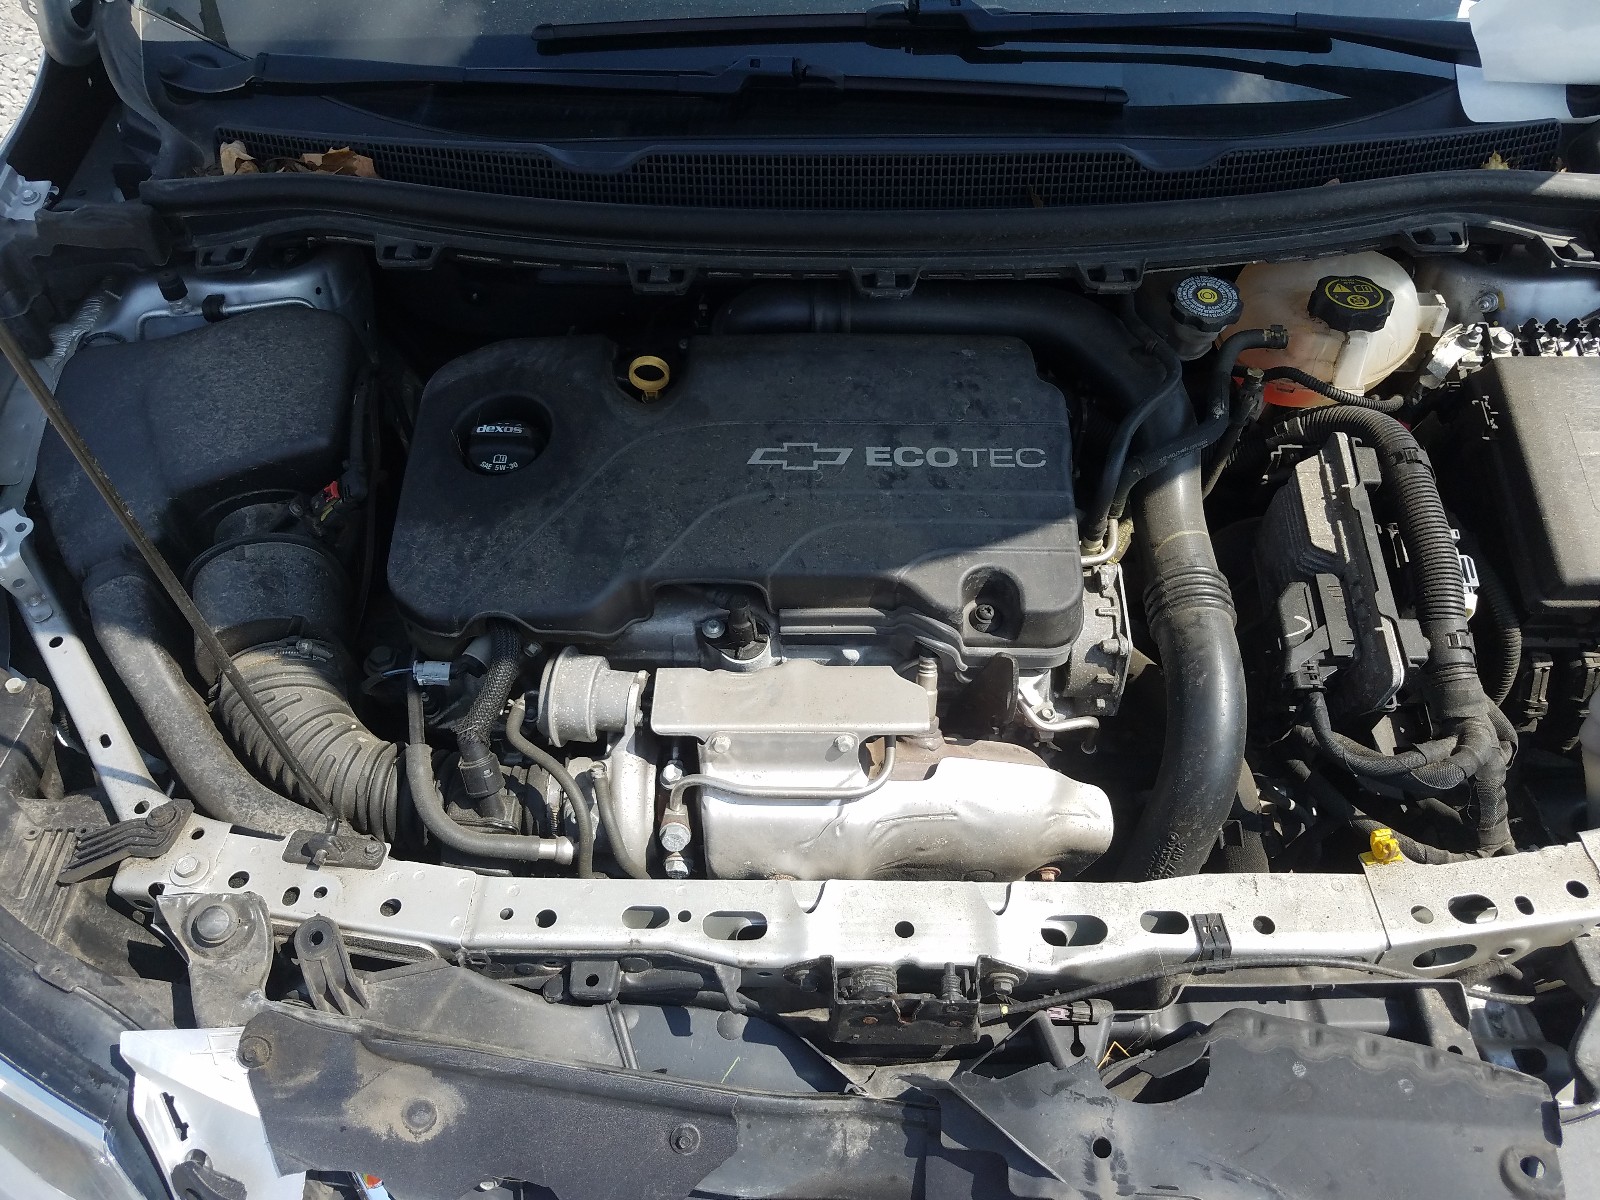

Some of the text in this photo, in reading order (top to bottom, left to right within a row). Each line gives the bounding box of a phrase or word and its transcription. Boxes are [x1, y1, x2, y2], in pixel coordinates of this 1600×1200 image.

[476, 424, 523, 434] dexos
[865, 446, 1047, 468] ECOTEC
[480, 461, 518, 471] SAE 5W-30
